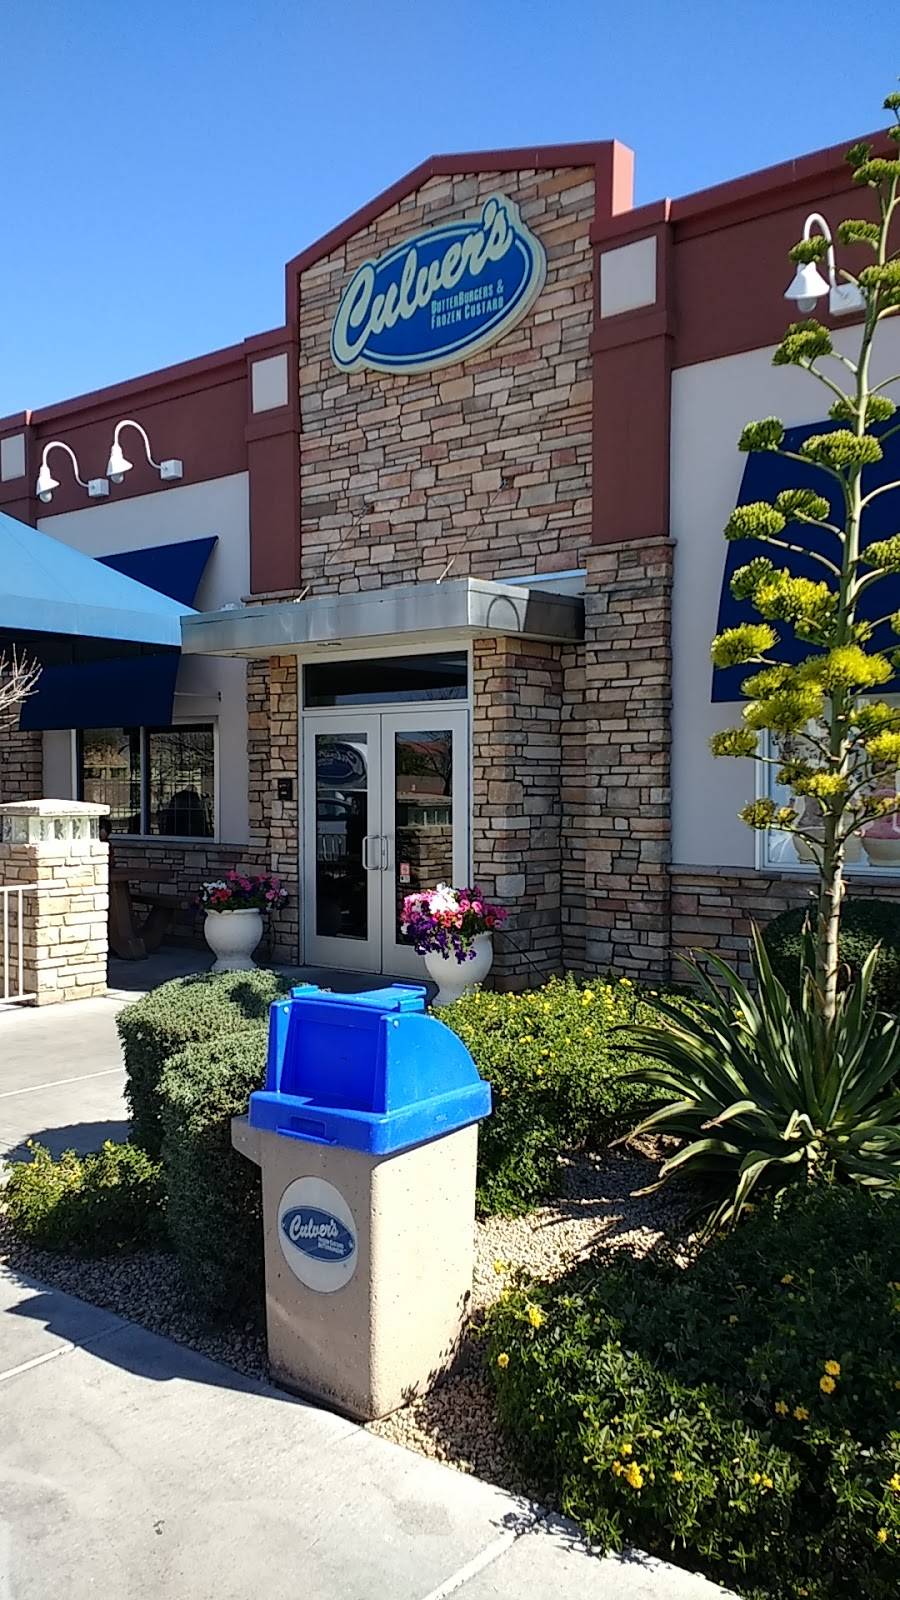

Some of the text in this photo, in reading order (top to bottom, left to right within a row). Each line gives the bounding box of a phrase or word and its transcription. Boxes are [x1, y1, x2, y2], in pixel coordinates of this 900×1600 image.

[334, 201, 513, 363] Culver's
[497, 279, 504, 294] &
[431, 296, 504, 330] FROZEN CUSTARD
[289, 1214, 339, 1241] Culver's
